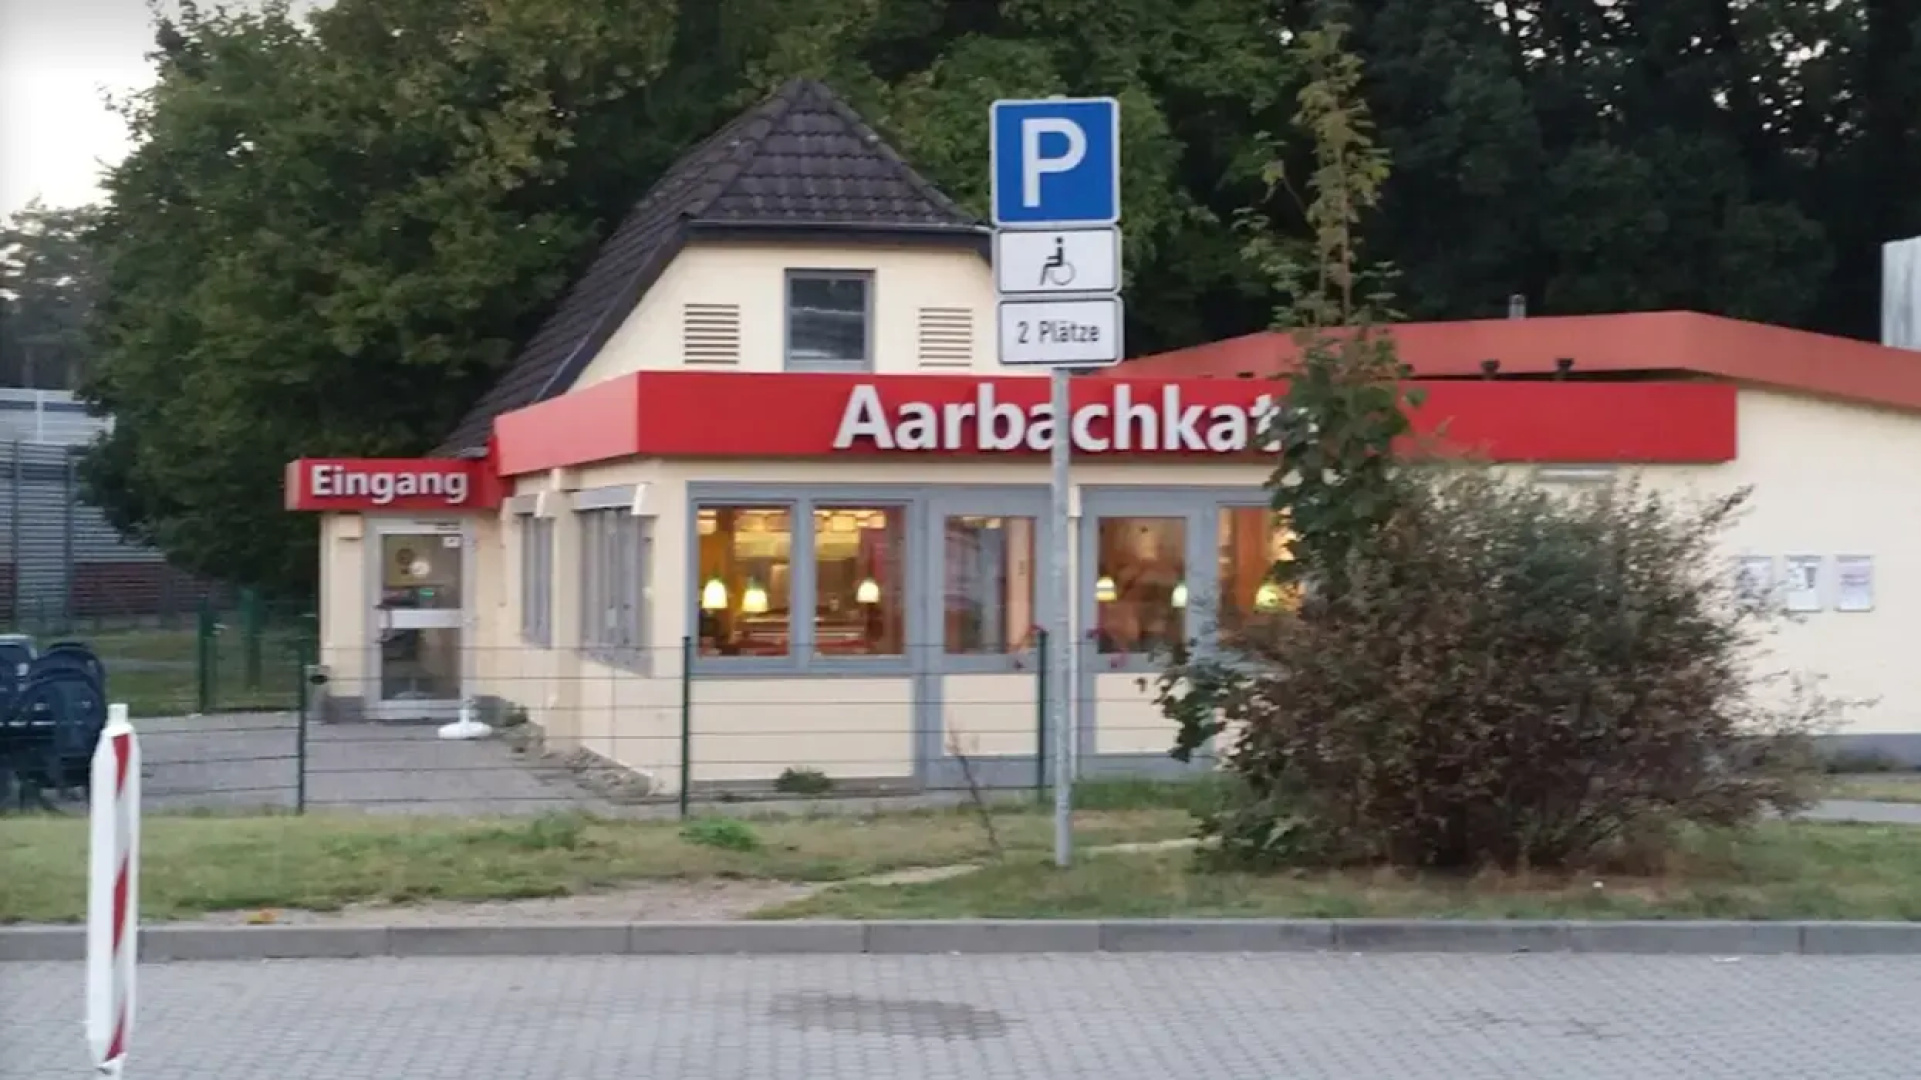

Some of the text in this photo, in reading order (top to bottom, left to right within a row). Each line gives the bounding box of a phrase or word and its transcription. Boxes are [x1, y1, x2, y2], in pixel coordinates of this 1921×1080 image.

[1022, 117, 1087, 207] P
[1017, 320, 1100, 344] 2 Plätze
[833, 382, 1320, 453] Aarbachkat
[312, 465, 469, 504] Eingang
